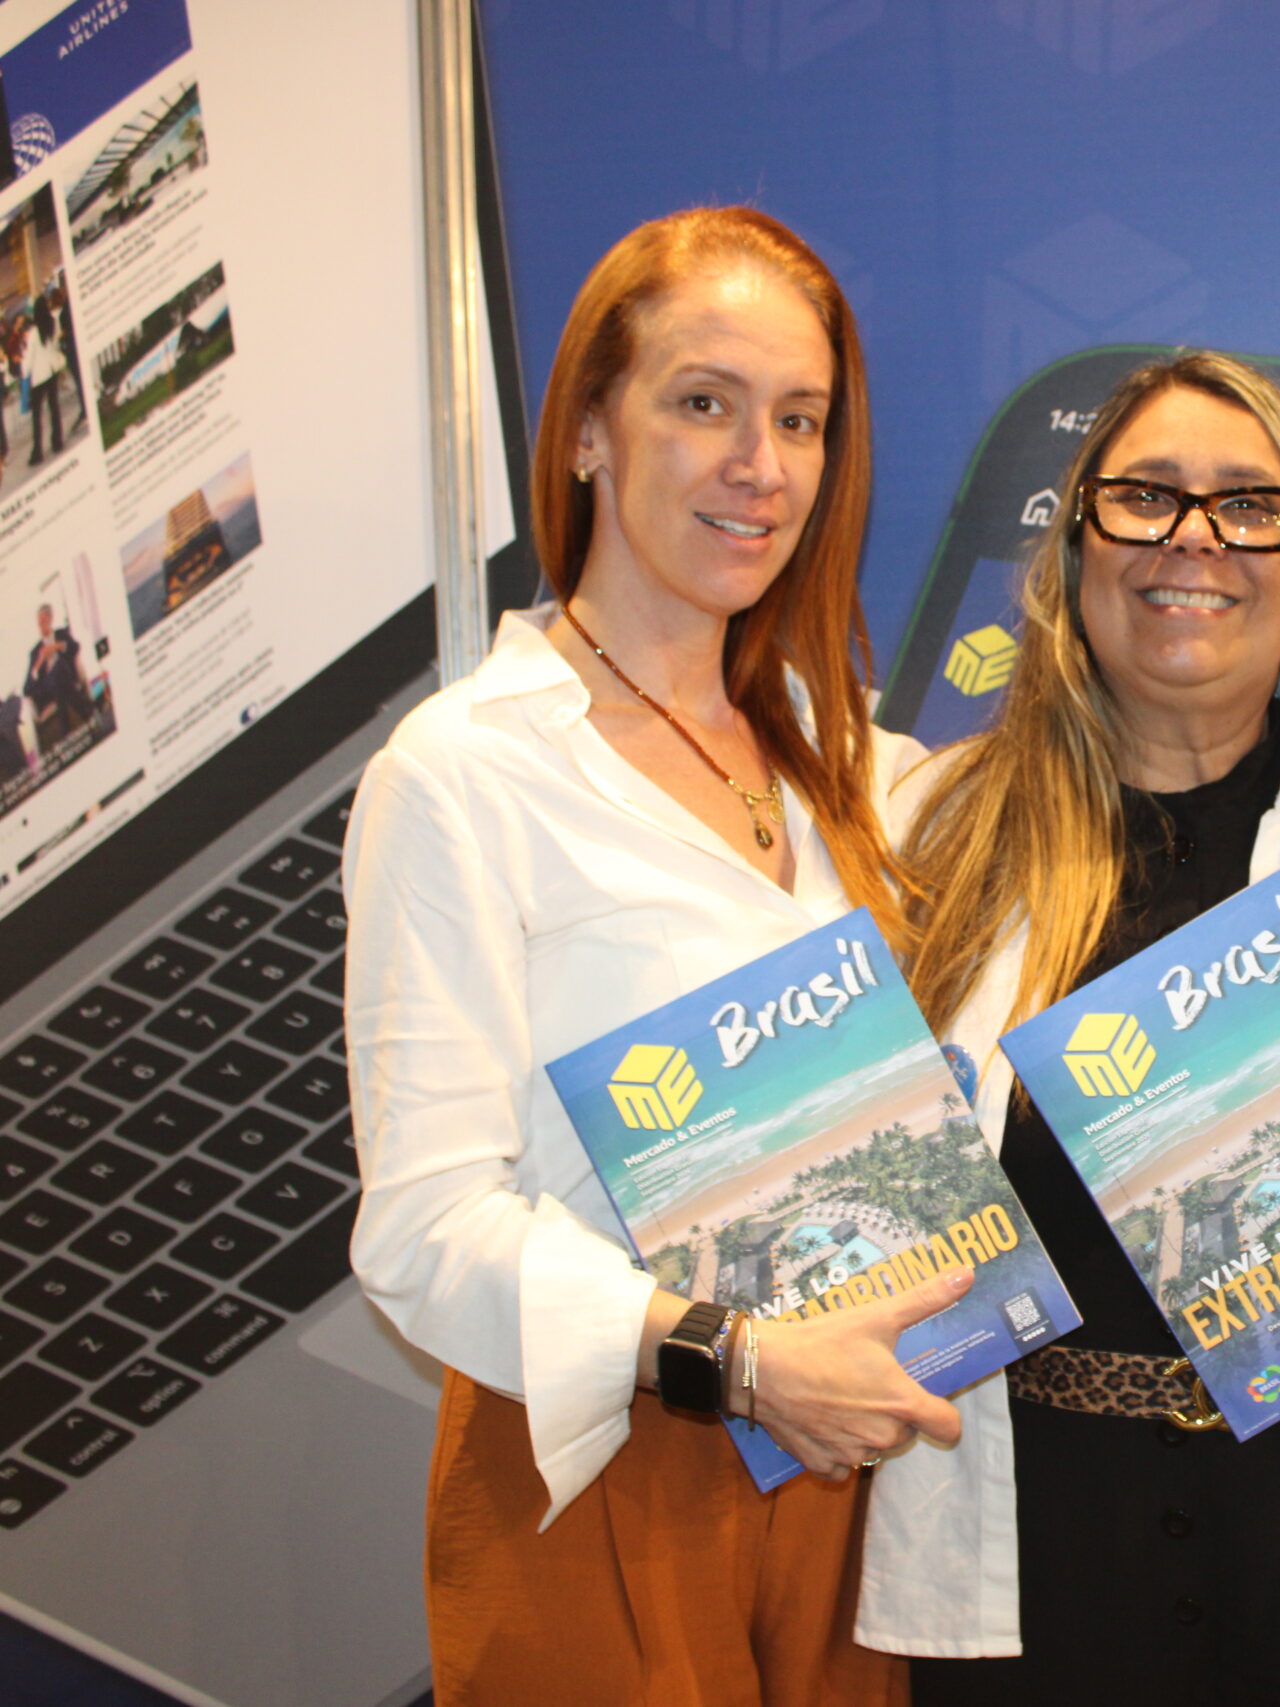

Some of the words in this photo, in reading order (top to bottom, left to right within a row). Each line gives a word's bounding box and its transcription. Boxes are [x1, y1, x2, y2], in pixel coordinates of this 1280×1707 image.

[58, 0, 129, 60] AIRLINES
[710, 938, 879, 1068] Brasil
[284, 1011, 309, 1028] U
[219, 1063, 241, 1076] Y
[305, 1078, 331, 1095] H
[1083, 1102, 1134, 1136] Mercado
[1145, 1068, 1191, 1100] Eventos
[154, 1113, 176, 1127] T
[623, 1135, 675, 1169] Mercado
[687, 1106, 737, 1138] Eventos
[89, 1162, 114, 1178] R
[174, 1177, 192, 1196] F
[276, 1184, 298, 1199] V
[25, 1212, 48, 1228] E
[108, 1230, 132, 1246] D
[211, 1236, 235, 1251] C
[1201, 1241, 1272, 1291] VIVE
[43, 1281, 66, 1295] S
[810, 1265, 849, 1296] LO
[145, 1287, 168, 1303] X
[79, 1337, 103, 1352] Z
[204, 1314, 268, 1365] command
[139, 1379, 184, 1413] option
[69, 1429, 118, 1466] control
